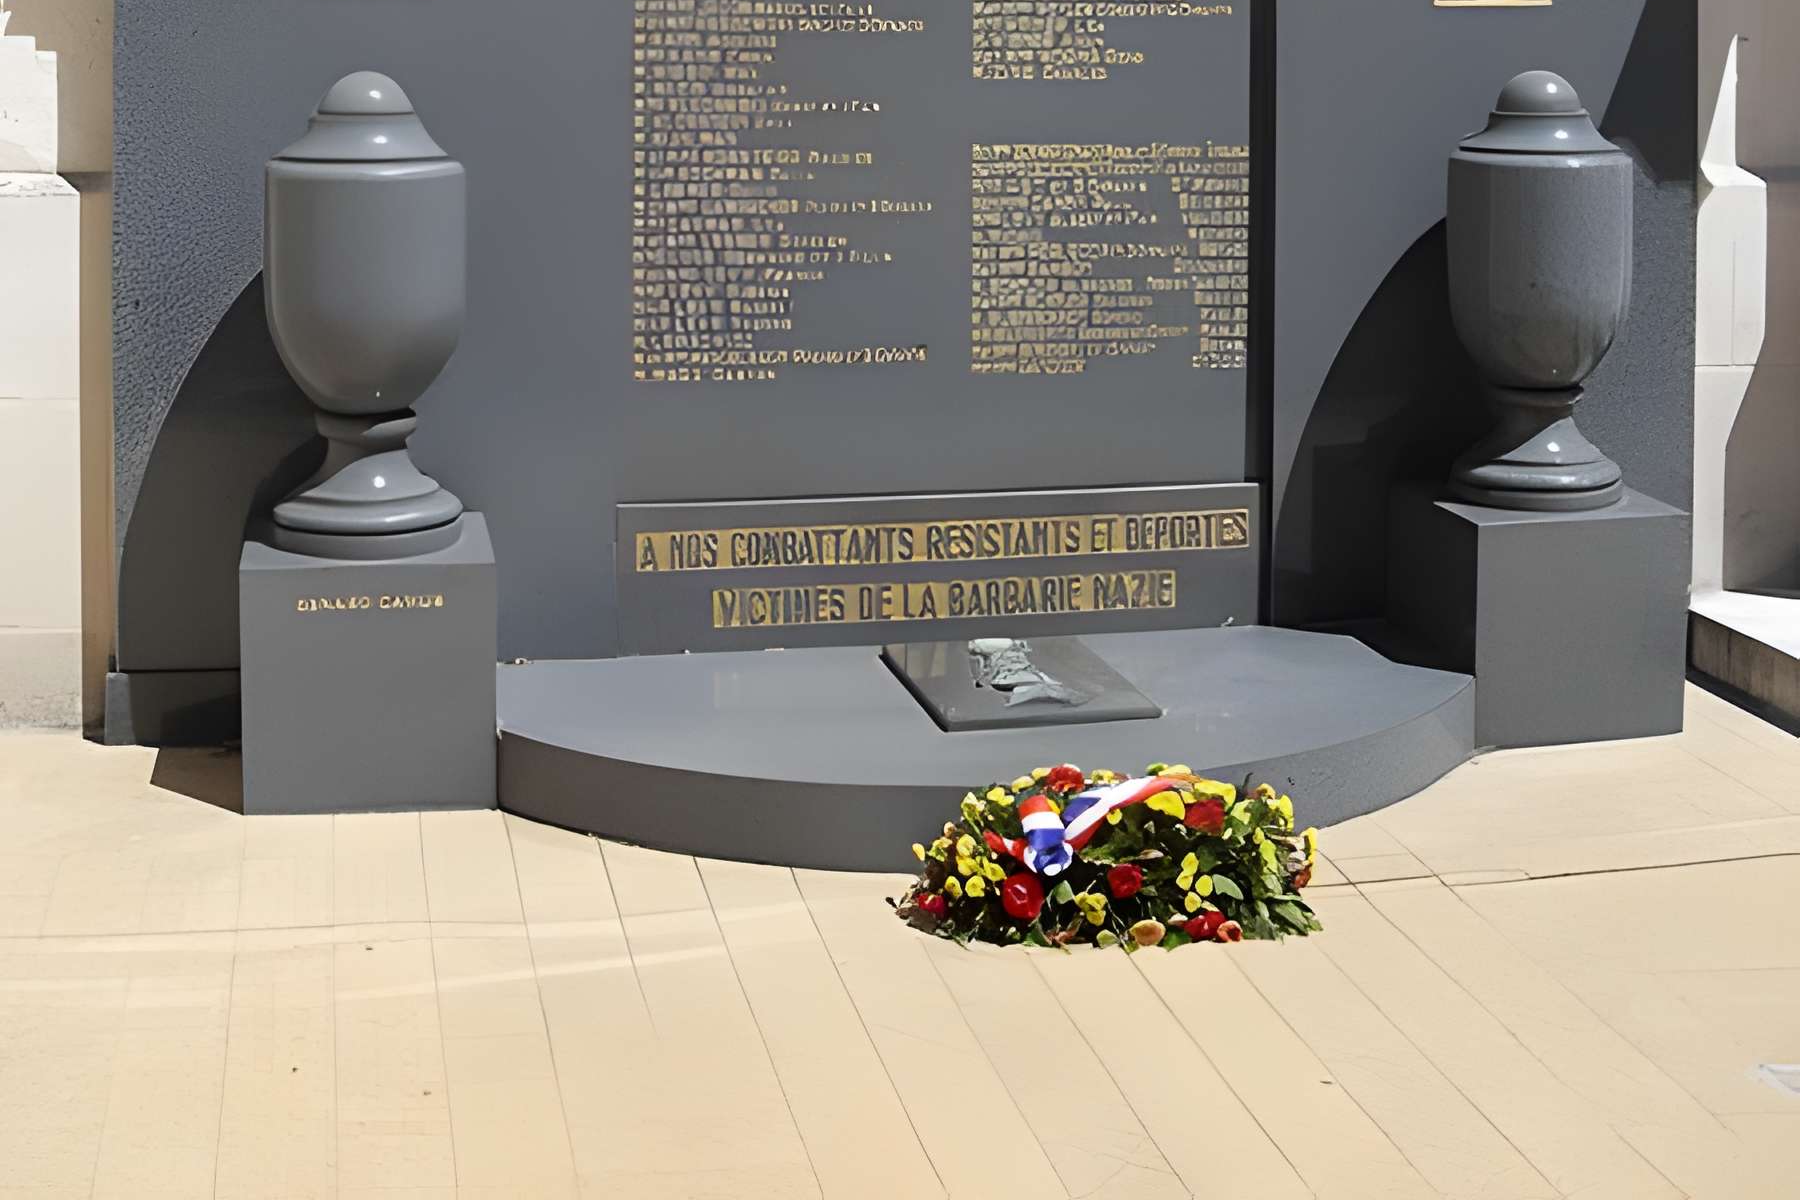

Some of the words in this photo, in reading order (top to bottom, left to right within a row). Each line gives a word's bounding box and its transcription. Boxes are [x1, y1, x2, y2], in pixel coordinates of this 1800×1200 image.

[639, 535, 659, 570] A
[669, 532, 719, 569] NOS
[926, 520, 1081, 560] RESISTANTS
[1091, 516, 1118, 552] ET
[859, 584, 893, 620] DE
[902, 583, 938, 619] LA
[948, 574, 1082, 617] BARBARIE
[1092, 571, 1175, 610] NAZIE
